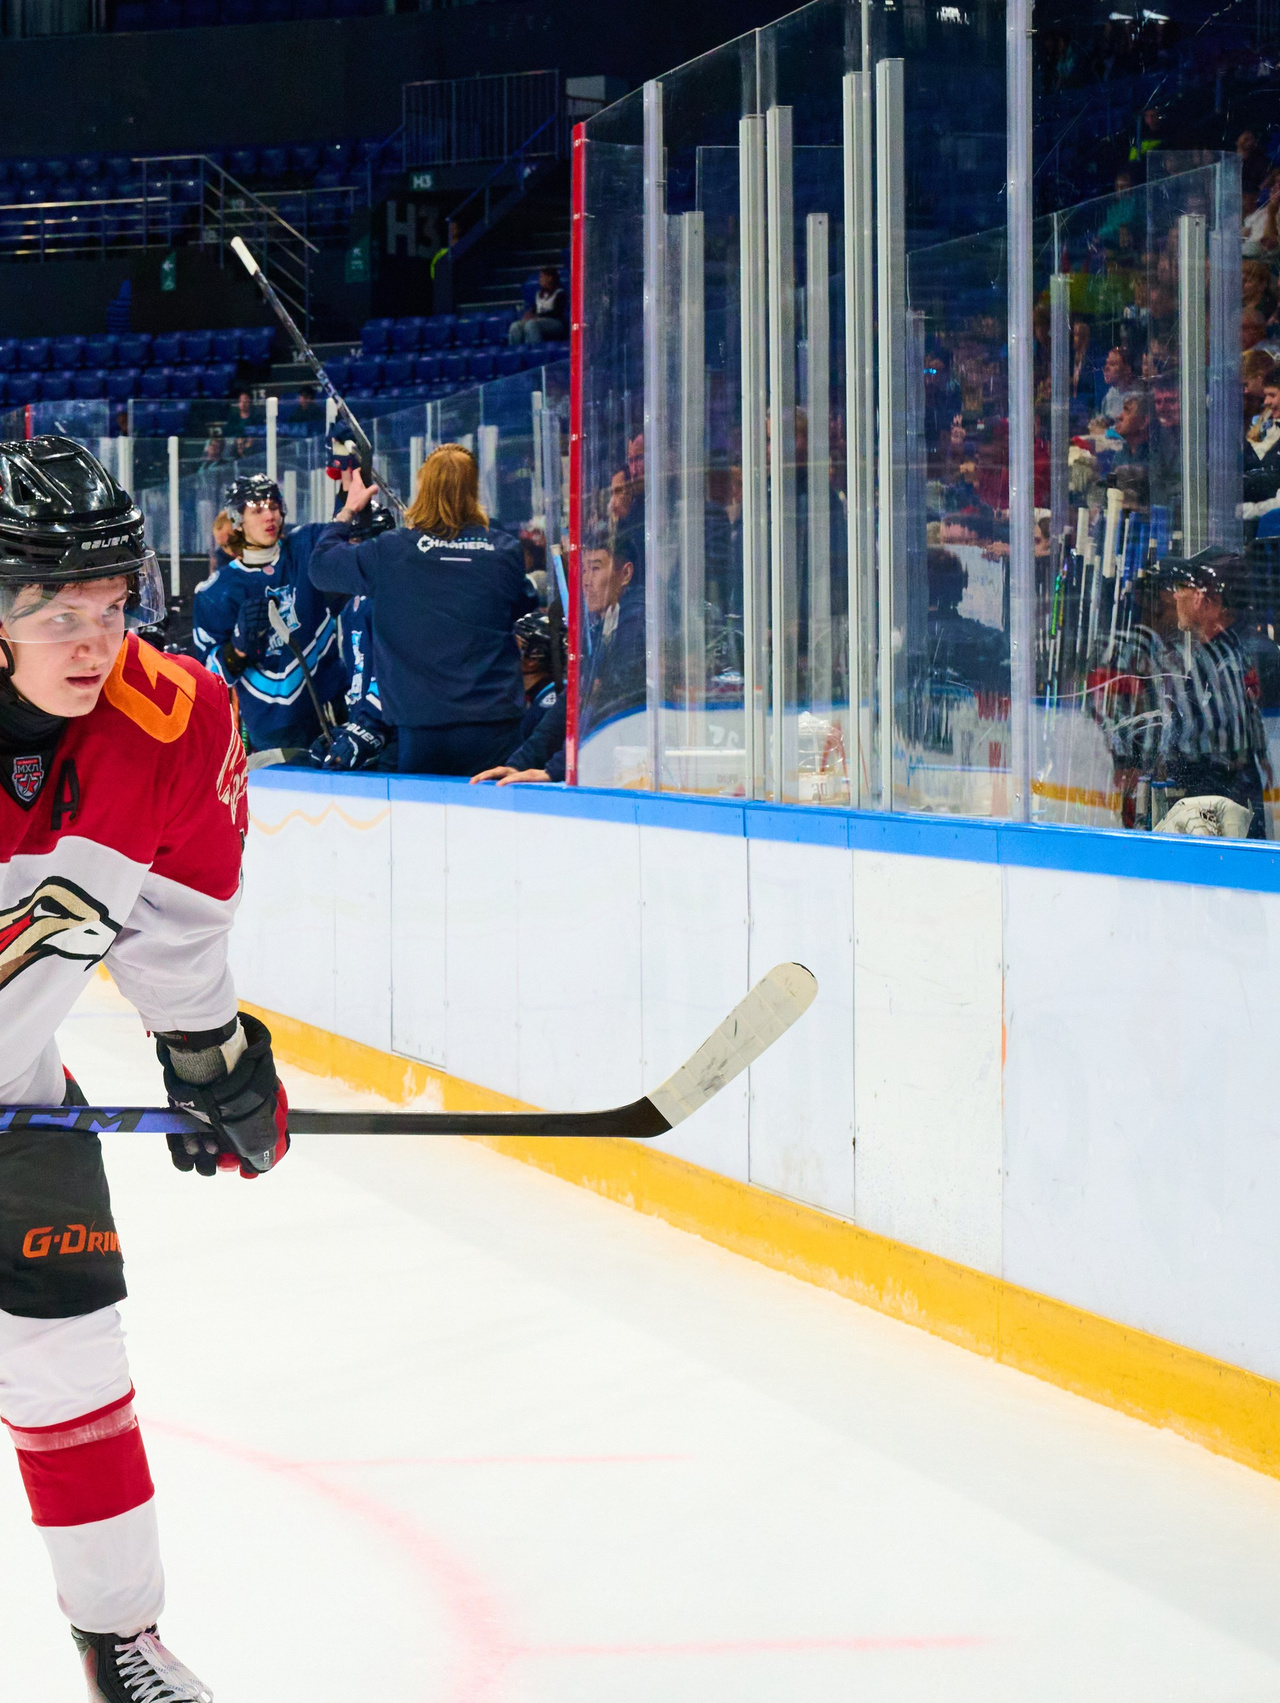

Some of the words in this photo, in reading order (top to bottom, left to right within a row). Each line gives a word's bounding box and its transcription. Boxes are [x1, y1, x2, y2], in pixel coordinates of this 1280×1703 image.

[412, 175, 432, 189] H3
[386, 201, 441, 258] H3
[18, 764, 39, 773] МХЛ
[51, 759, 80, 831] A
